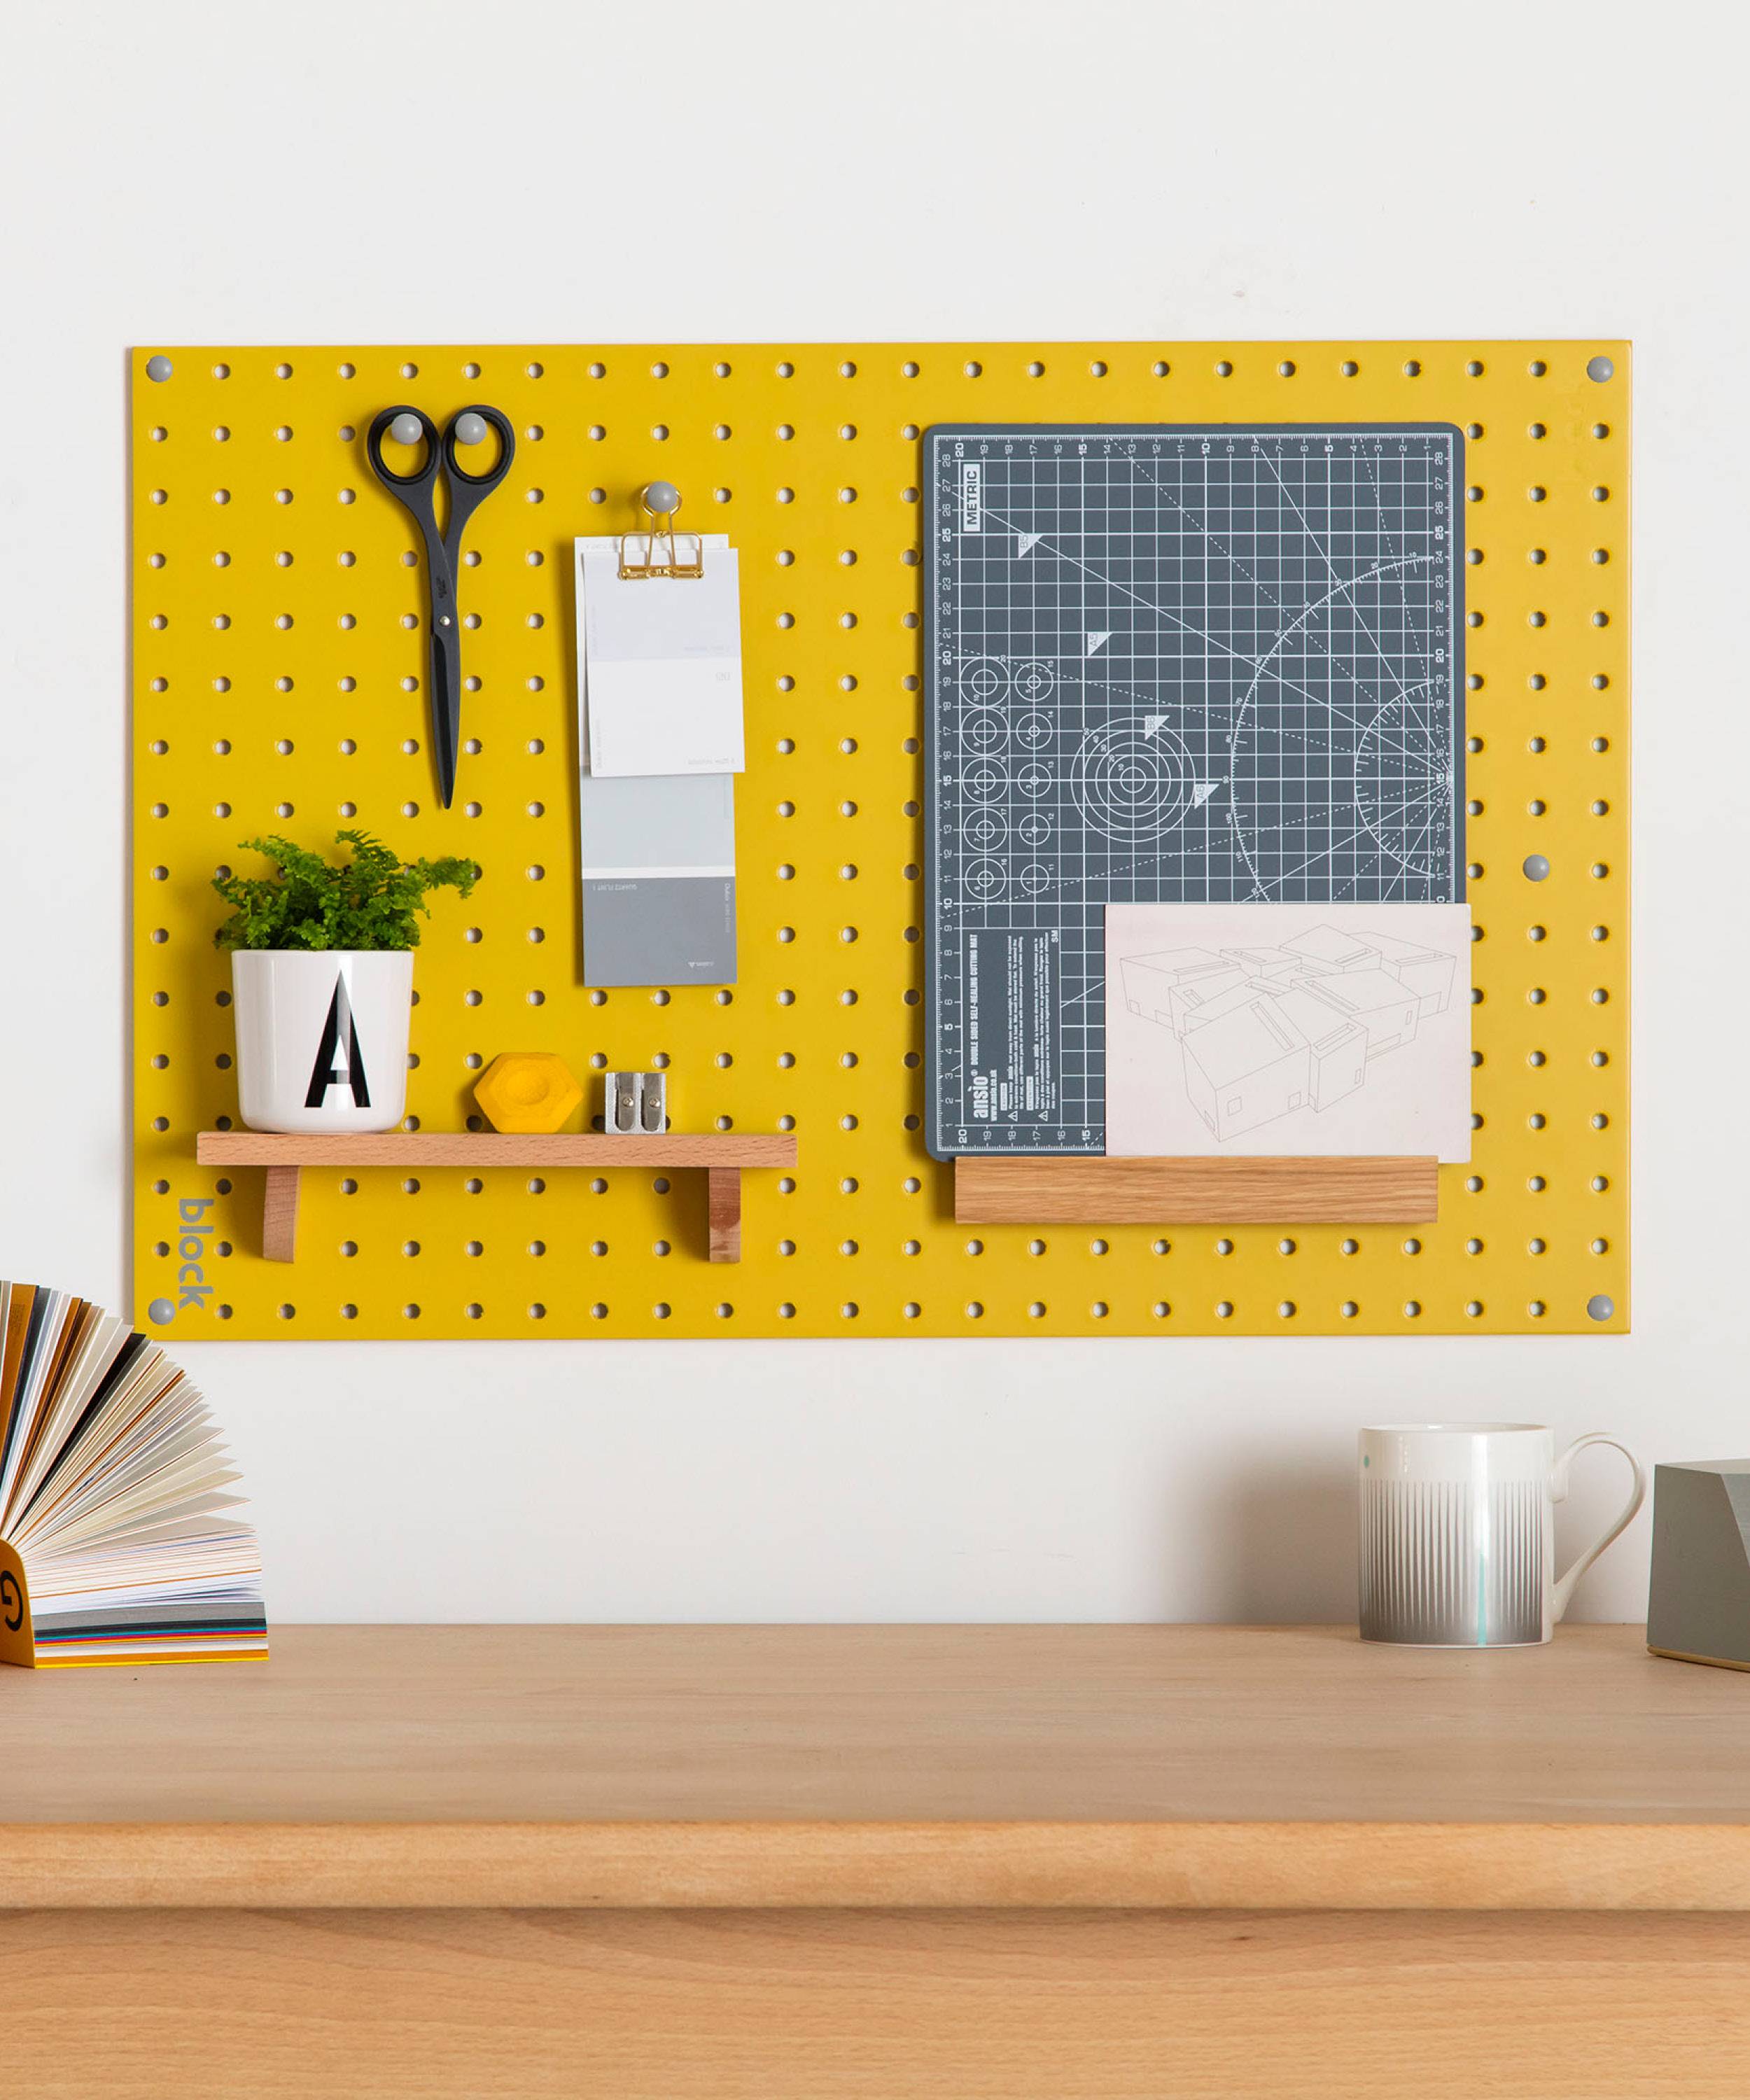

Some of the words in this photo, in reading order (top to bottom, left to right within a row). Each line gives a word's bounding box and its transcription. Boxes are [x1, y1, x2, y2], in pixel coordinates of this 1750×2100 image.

[955, 443, 963, 457] 20
[980, 444, 988, 455] 19
[1005, 444, 1013, 454] 18
[1029, 444, 1037, 454] 17
[1054, 444, 1062, 454] 16
[1079, 444, 1087, 455] 15
[1104, 444, 1111, 454] 14
[1128, 444, 1136, 454] 13
[1152, 444, 1161, 454] 12
[1202, 442, 1210, 454] 10
[942, 454, 951, 466] 28
[1435, 451, 1443, 465] 28
[942, 479, 951, 491] 27
[1435, 477, 1443, 490] 27
[967, 470, 976, 524] METRIC
[942, 504, 951, 517] 26
[1435, 501, 1443, 514] 26
[942, 528, 951, 542] 25
[1435, 526, 1443, 540] 25
[942, 553, 951, 566] 24
[1435, 551, 1443, 564] 24
[943, 578, 951, 590] 23
[1436, 575, 1444, 588] 23
[943, 602, 951, 615] 22
[1436, 599, 1444, 613] 22
[943, 628, 951, 638] 21
[1436, 626, 1444, 637] 21
[943, 650, 951, 665] 20
[1436, 648, 1444, 663] 20
[943, 677, 951, 687] 19
[1436, 674, 1444, 685] 19
[943, 701, 951, 711] 18
[1436, 699, 1444, 710] 18
[943, 727, 951, 736] 17
[1436, 724, 1444, 734] 17
[943, 750, 951, 760] 16
[1436, 748, 1444, 758] 16
[943, 775, 951, 787] 15
[1436, 773, 1444, 783] 15
[944, 800, 952, 810] 14
[1436, 798, 1444, 808] 14
[944, 825, 952, 834] 13
[1436, 822, 1445, 832] 13
[944, 849, 952, 859] 12
[1436, 847, 1445, 857] 12
[944, 874, 952, 883] 11
[1436, 872, 1445, 881] 11
[944, 897, 952, 908] 10
[1051, 930, 1058, 942] SM
[969, 949, 978, 976] CUTTING
[304, 969, 371, 1107] A
[959, 1129, 967, 1144] 20
[983, 1130, 992, 1141] 19
[1008, 1130, 1016, 1141] 18
[1032, 1130, 1041, 1141] 17
[1058, 1130, 1065, 1141] 16
[1082, 1129, 1091, 1141] 15
[178, 1198, 214, 1310] block
[0, 1571, 22, 1632] G
